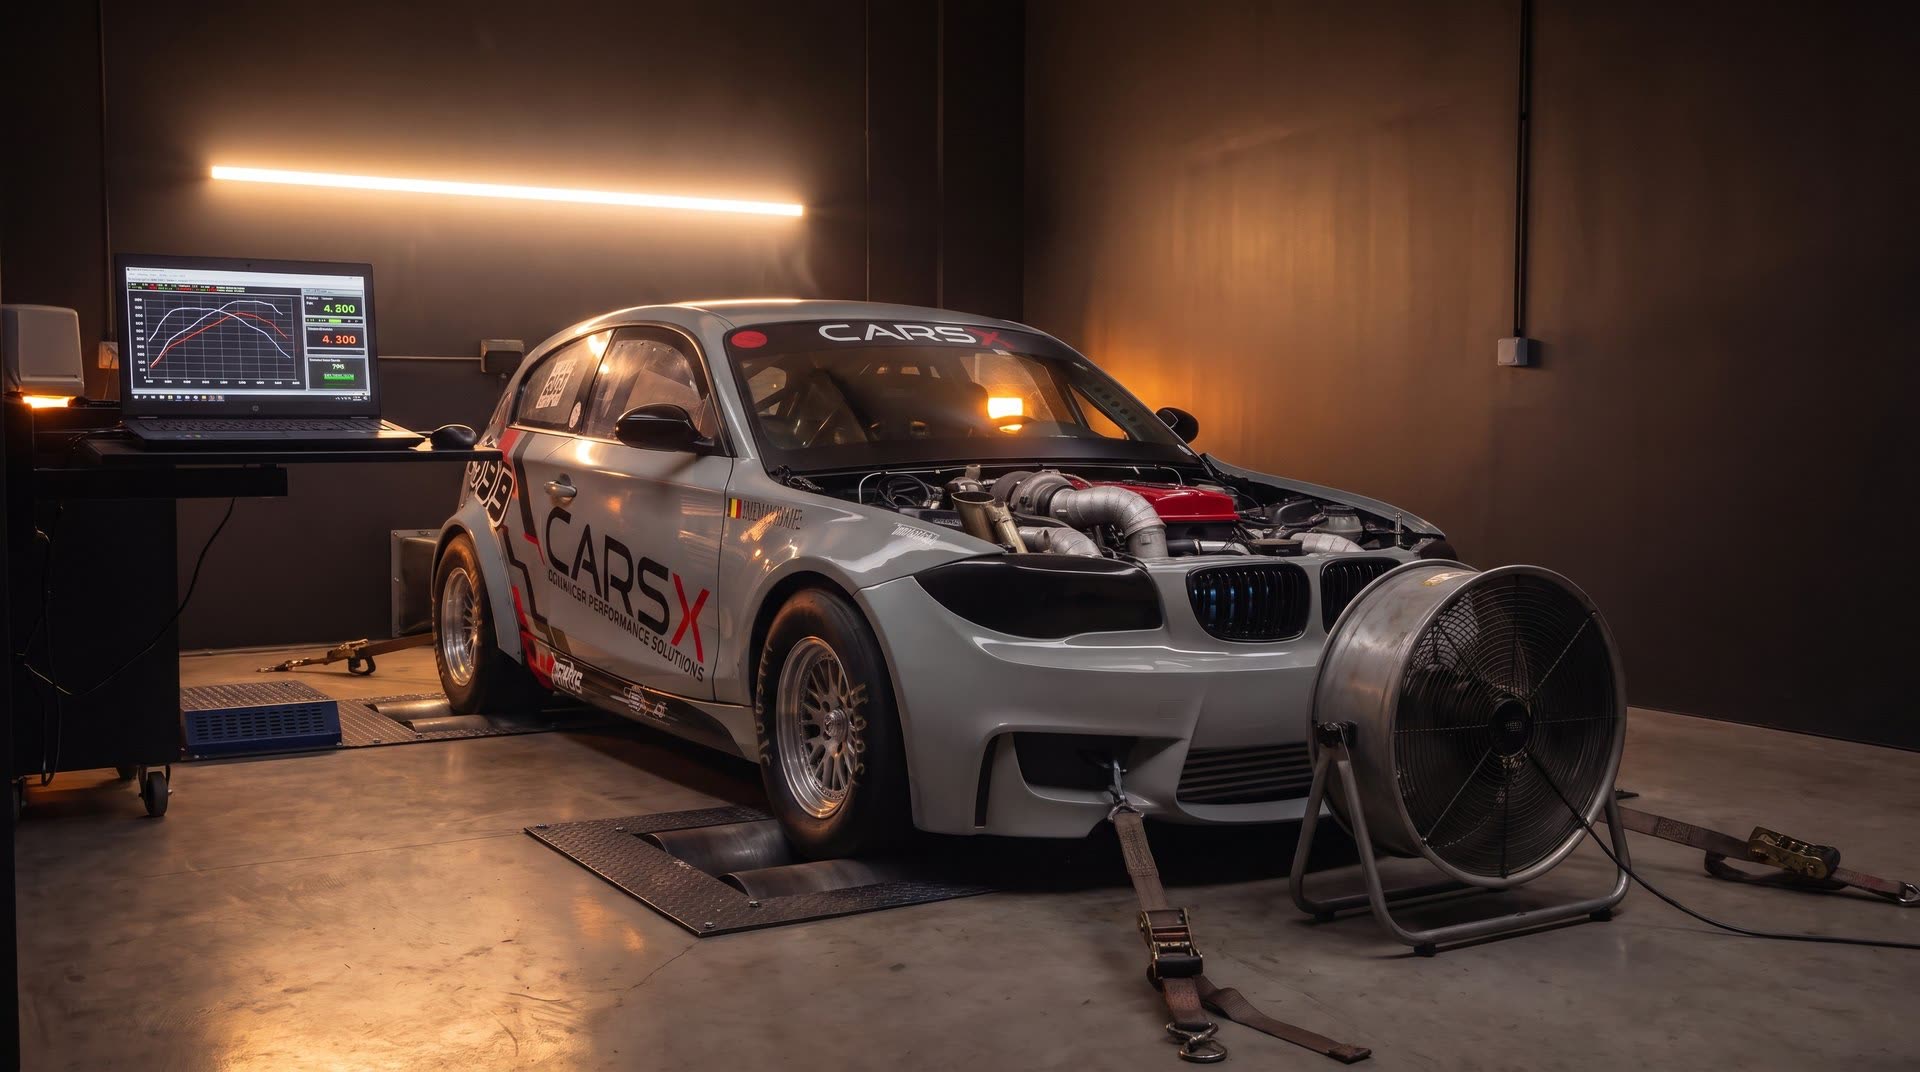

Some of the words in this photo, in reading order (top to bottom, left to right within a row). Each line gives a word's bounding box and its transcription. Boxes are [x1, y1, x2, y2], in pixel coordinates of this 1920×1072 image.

[819, 324, 1015, 348] CARSX
[546, 506, 711, 663] CARSX
[588, 594, 649, 646] PERFORMANCE
